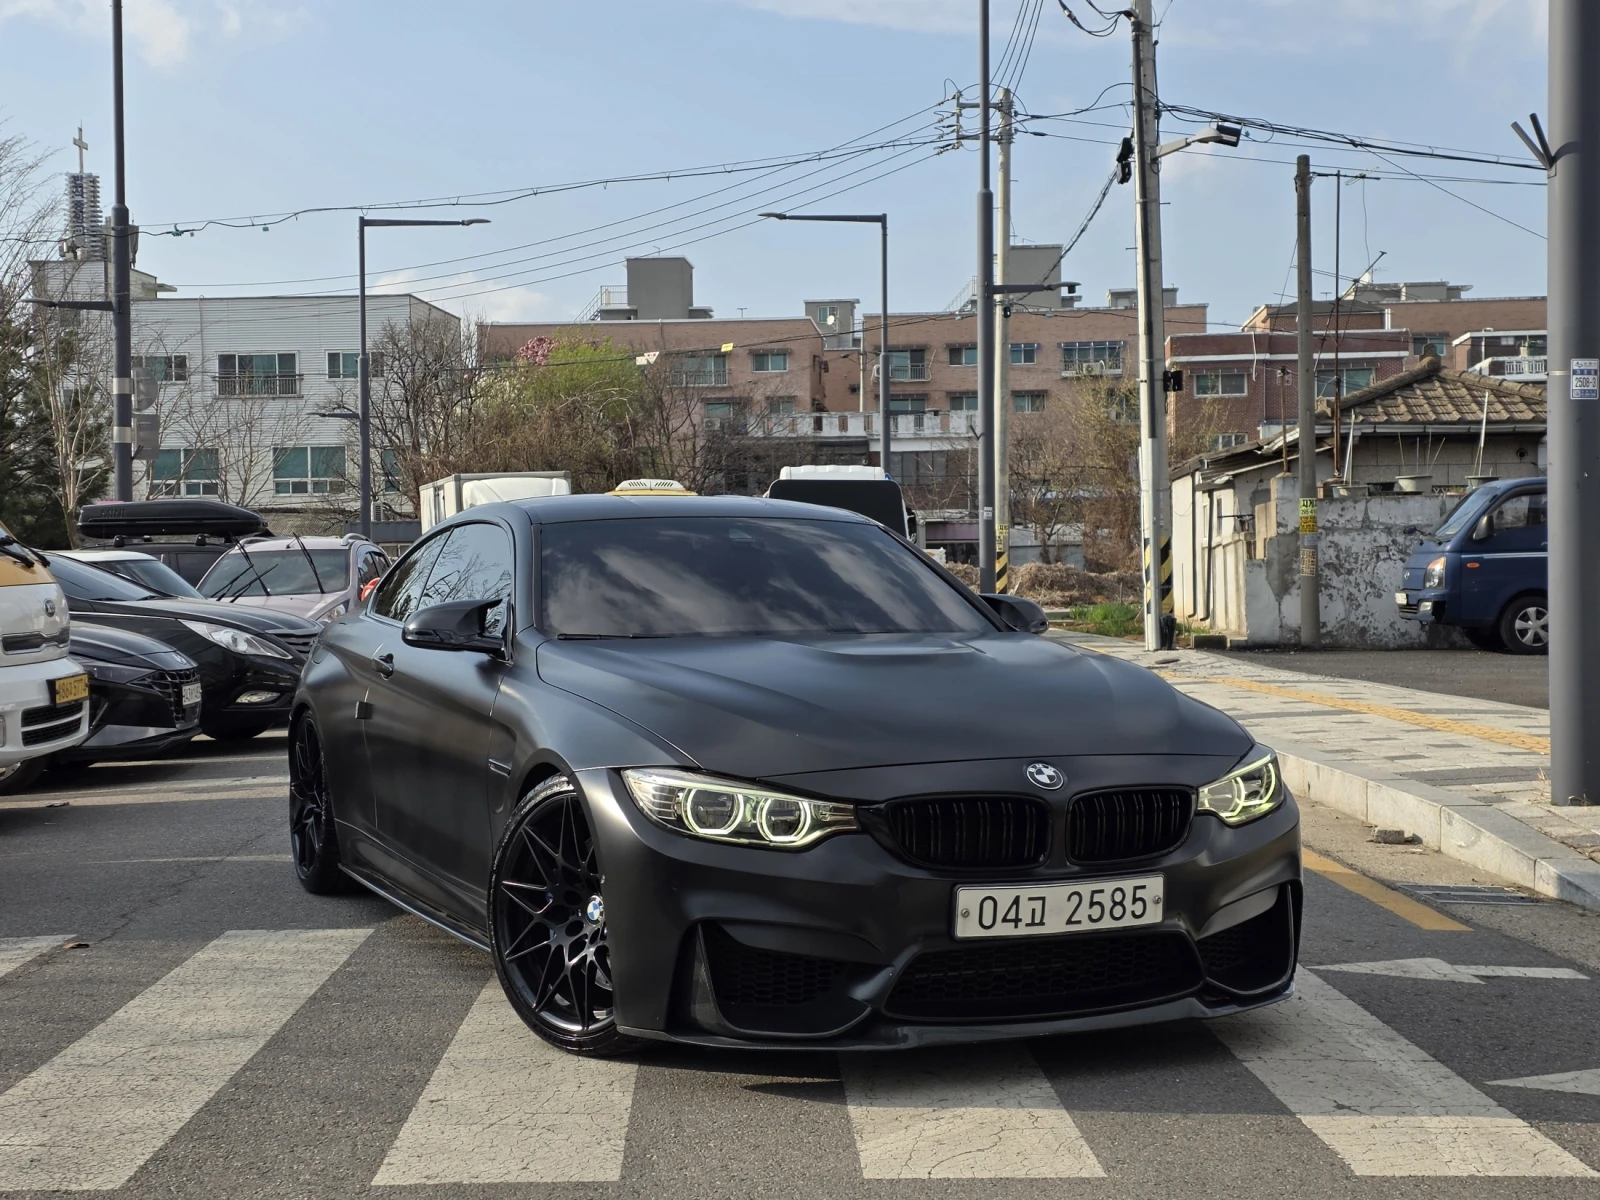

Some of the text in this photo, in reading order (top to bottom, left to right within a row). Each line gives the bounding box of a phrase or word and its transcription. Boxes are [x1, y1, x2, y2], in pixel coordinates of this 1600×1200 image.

[1575, 376, 1597, 388] 2508-3
[978, 884, 1147, 931] 04고 2585
